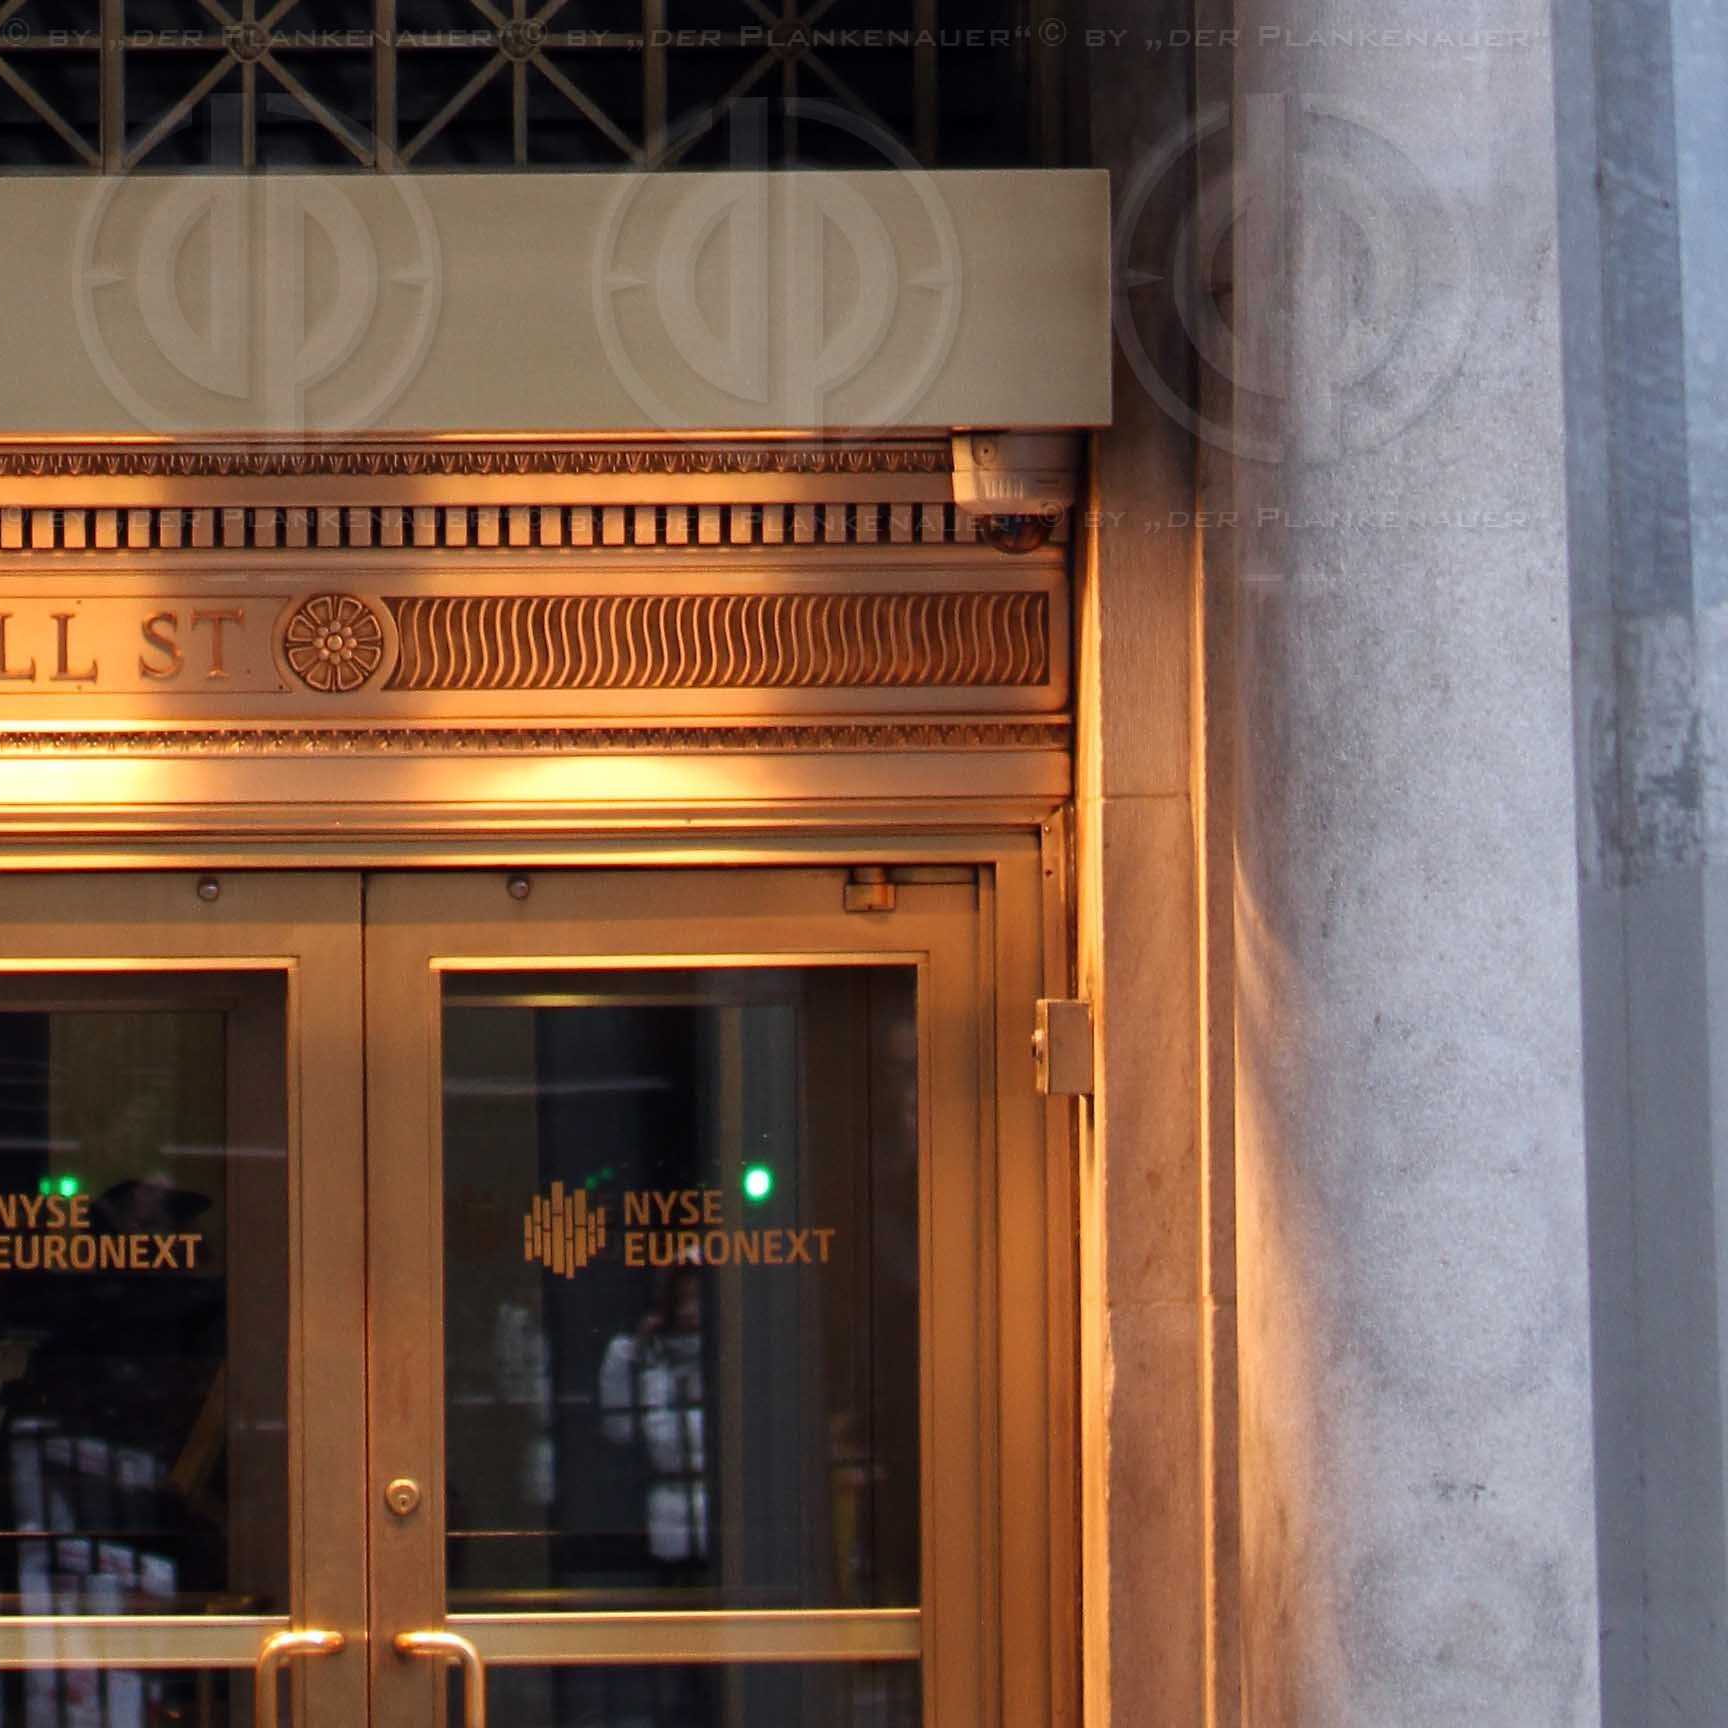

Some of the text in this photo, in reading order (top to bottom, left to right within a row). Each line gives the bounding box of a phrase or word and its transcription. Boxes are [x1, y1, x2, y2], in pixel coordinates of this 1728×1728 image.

[138, 608, 246, 681] ST
[624, 1190, 725, 1226] NYSE
[623, 1228, 837, 1267] EURONEXT
